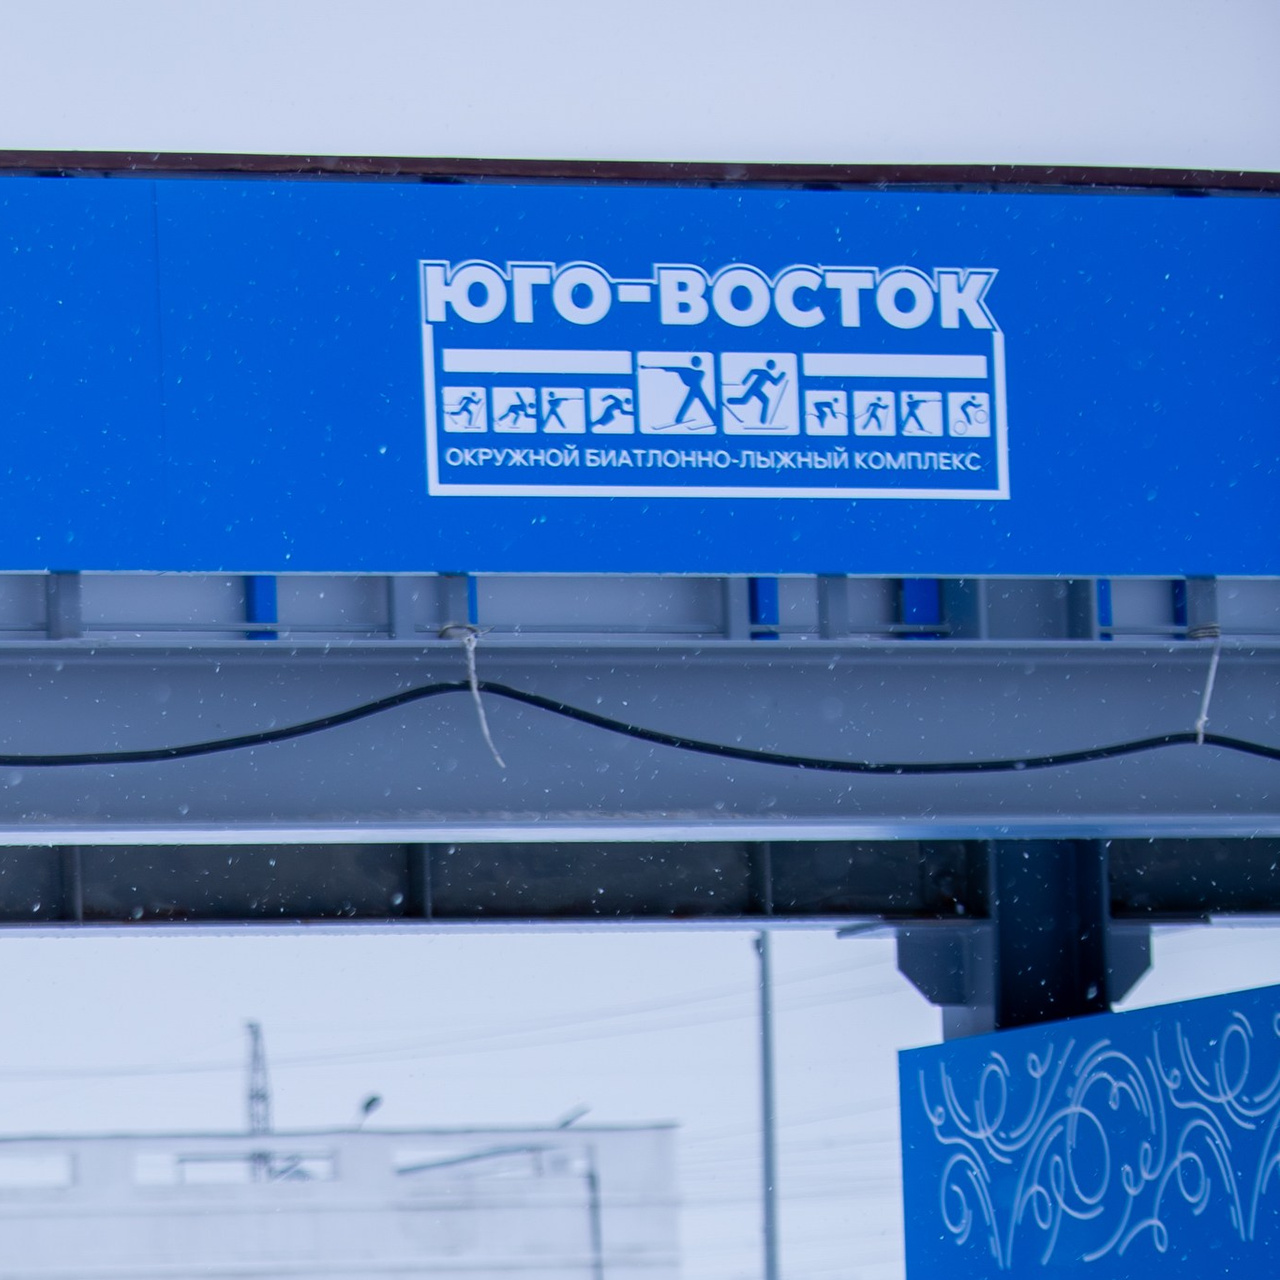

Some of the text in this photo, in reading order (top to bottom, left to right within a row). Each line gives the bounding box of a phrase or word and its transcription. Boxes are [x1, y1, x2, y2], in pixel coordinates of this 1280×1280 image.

[424, 263, 995, 330] ЮГО-ВОСТОК
[445, 444, 982, 471] ОКРУЖНОЙ БИАТЛОННО-ЛЫЖНЫЙ КОМПЛЕКС
